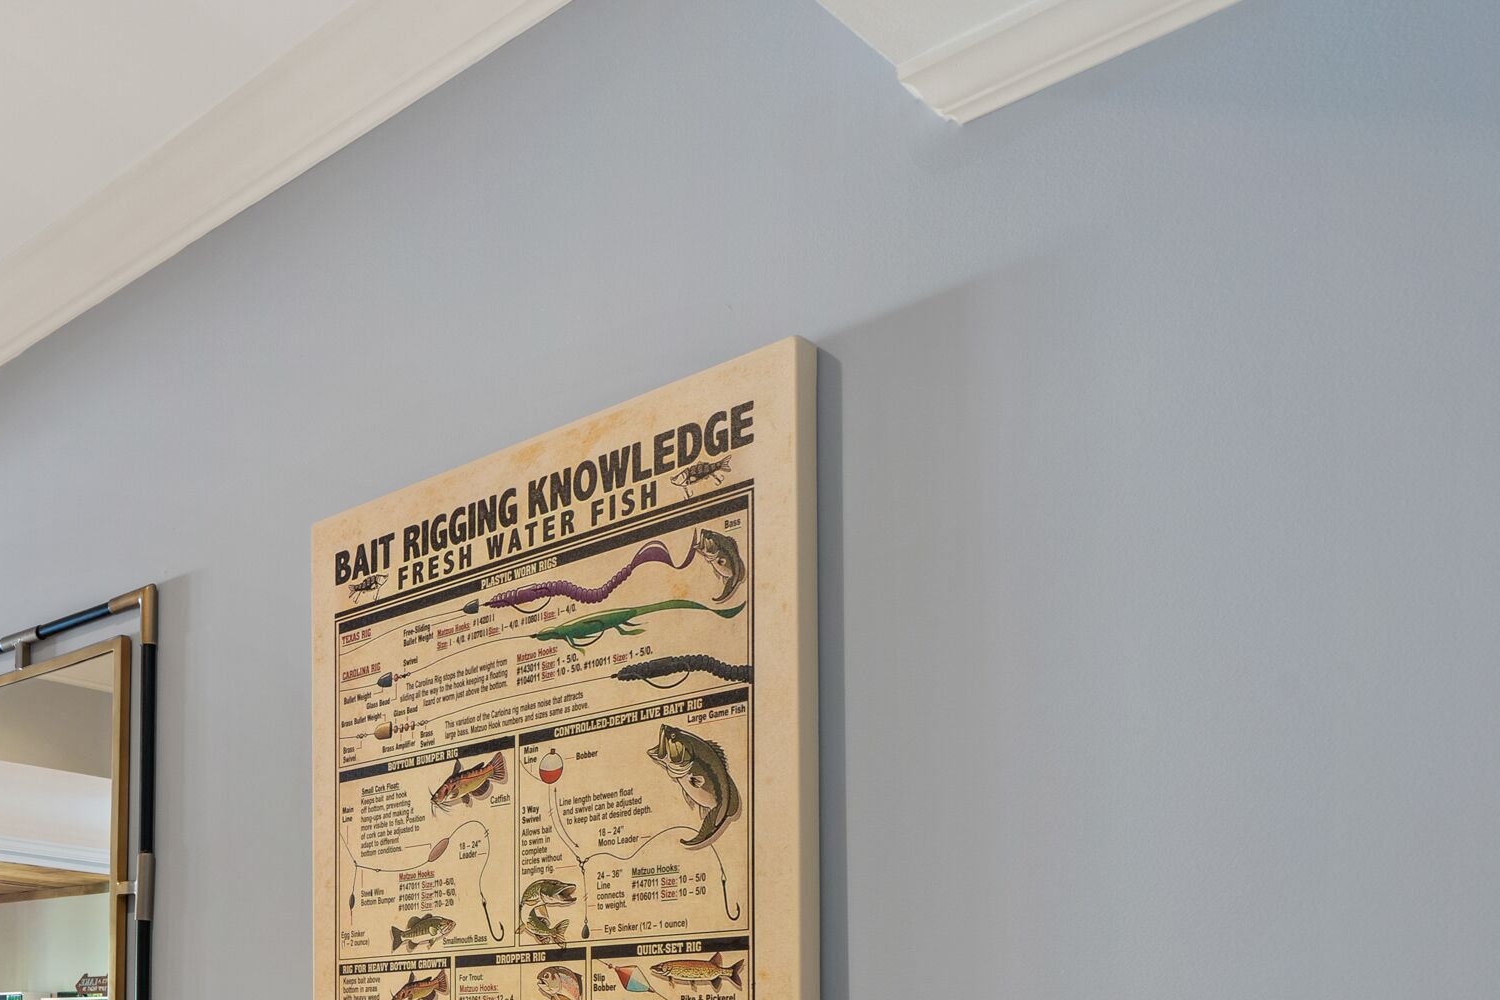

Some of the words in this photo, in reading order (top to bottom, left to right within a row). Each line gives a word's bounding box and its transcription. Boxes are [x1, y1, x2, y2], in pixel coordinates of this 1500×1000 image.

[335, 532, 395, 586] BAIT
[403, 486, 518, 563] RIGGING
[528, 400, 754, 519] KNOWLEDGE
[725, 516, 740, 530] Bass
[398, 544, 472, 590] FRESH
[487, 508, 574, 561] WATER
[591, 481, 656, 527] FISH
[481, 570, 513, 590] PLASTIC
[514, 562, 537, 579] WORN
[539, 556, 557, 572] RIGS
[342, 632, 360, 645] TEXAS
[362, 629, 371, 639] RIG
[343, 666, 369, 680] CAROLINA
[371, 663, 380, 673] RIG
[554, 712, 637, 738] CONTROLLED-DEPTH
[641, 707, 660, 720] LIVE
[663, 702, 684, 716] BAIT
[687, 698, 703, 711] RIG
[688, 711, 707, 725] Large
[709, 707, 729, 719] Game
[731, 704, 745, 715] Fish
[524, 745, 538, 754] Main
[576, 749, 598, 760] Bobber
[388, 758, 414, 771] BOTTOM
[417, 752, 444, 765] BUMPER
[447, 749, 458, 759] RIG
[524, 755, 537, 764] Line
[490, 793, 510, 804] Catfish
[559, 797, 571, 806] Line
[573, 794, 591, 807] length
[593, 790, 617, 801] between
[619, 787, 633, 797] float
[527, 805, 539, 815] Way
[563, 807, 573, 816] and
[575, 804, 593, 814] swivel
[595, 803, 604, 811] can
[606, 801, 614, 809] be
[616, 796, 642, 809] adjusted
[522, 814, 541, 824] Swivel
[567, 817, 573, 825] to
[574, 815, 588, 826] keep
[590, 813, 600, 822] bait
[609, 808, 631, 819] desired
[633, 805, 652, 818] depth.
[522, 827, 540, 837] Allows
[542, 825, 552, 834] bait
[529, 837, 543, 845] swim
[599, 838, 615, 846] Mono
[617, 834, 639, 844] Leader
[522, 846, 547, 857] complete
[522, 856, 540, 865] circles
[541, 853, 562, 863] without
[522, 866, 544, 877] tangling
[546, 865, 555, 874] rig.
[632, 866, 655, 876] Matzuo
[657, 863, 679, 873] Hooks:
[597, 881, 610, 889] Line
[597, 891, 625, 900] connects
[605, 901, 627, 911] weight.
[443, 936, 473, 945] Smallmouth
[474, 934, 487, 942] Bass
[637, 942, 684, 956] QUICK-SET
[686, 941, 702, 952] RIG
[496, 953, 531, 964] DROPPER
[533, 952, 546, 962] RIG
[343, 965, 352, 974] RIG
[355, 964, 366, 973] FOR
[368, 963, 388, 972] HEAVY
[390, 961, 417, 970] BOTTOM
[419, 959, 447, 969] GROWTH
[469, 973, 483, 981] Trout:
[594, 974, 605, 983] Slip
[594, 984, 616, 992] Bobber
